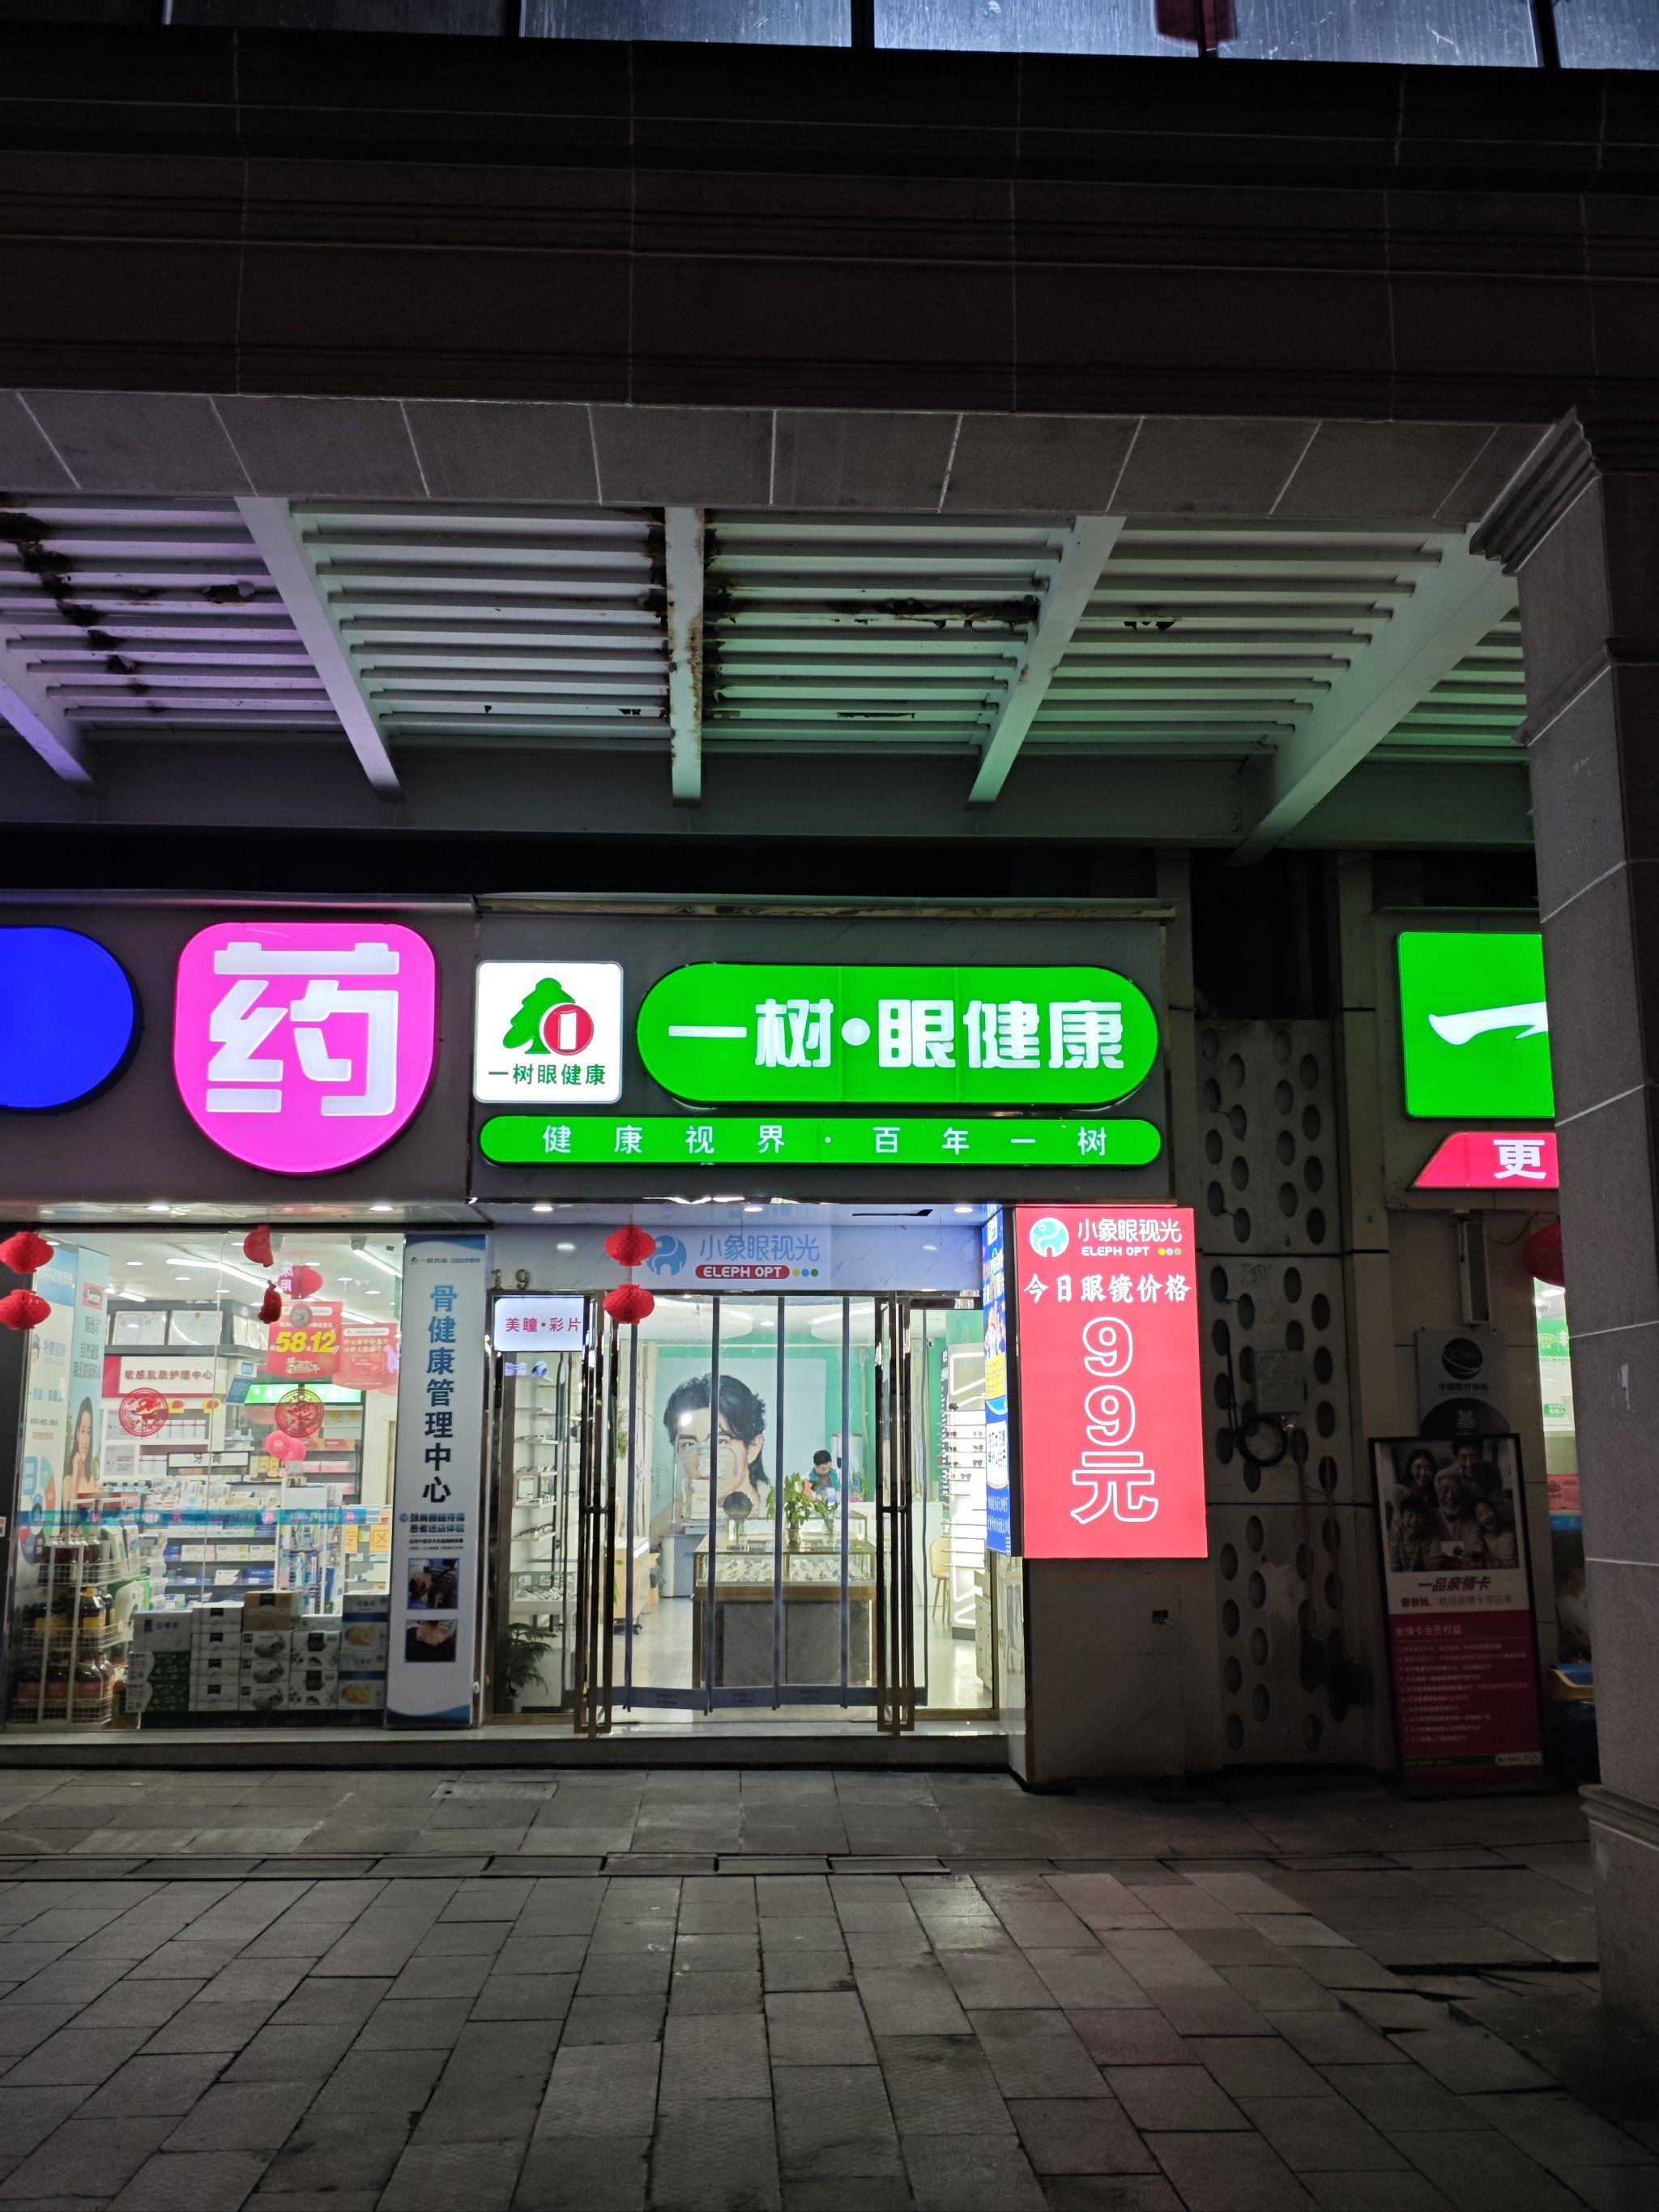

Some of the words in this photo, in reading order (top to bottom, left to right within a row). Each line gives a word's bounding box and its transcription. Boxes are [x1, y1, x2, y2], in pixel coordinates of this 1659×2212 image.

[206, 942, 400, 1117] 药
[488, 1063, 606, 1085] 一树眼健康
[1493, 1139, 1547, 1180] 更
[1077, 1217, 1183, 1243] 小象眼视光
[700, 1234, 821, 1262] 小象眼视光
[1081, 1246, 1123, 1256] ELEPH
[1125, 1246, 1150, 1256] OPT
[703, 1267, 750, 1278] ELEPH
[755, 1267, 783, 1278] OPT
[1023, 1272, 1192, 1304] 今日眼镜价格
[505, 1317, 582, 1332] 美瞳·彩片
[125, 1370, 214, 1380] 敏感肌肤护理中心
[422, 1285, 458, 1503] 骨健康管理中心
[193, 1453, 222, 1464] 牙膏
[410, 1524, 465, 1533] 患者进店体验
[1418, 1575, 1492, 1592] 一品亲情卡
[1395, 1624, 1462, 1638] 亲情卡会员权益
